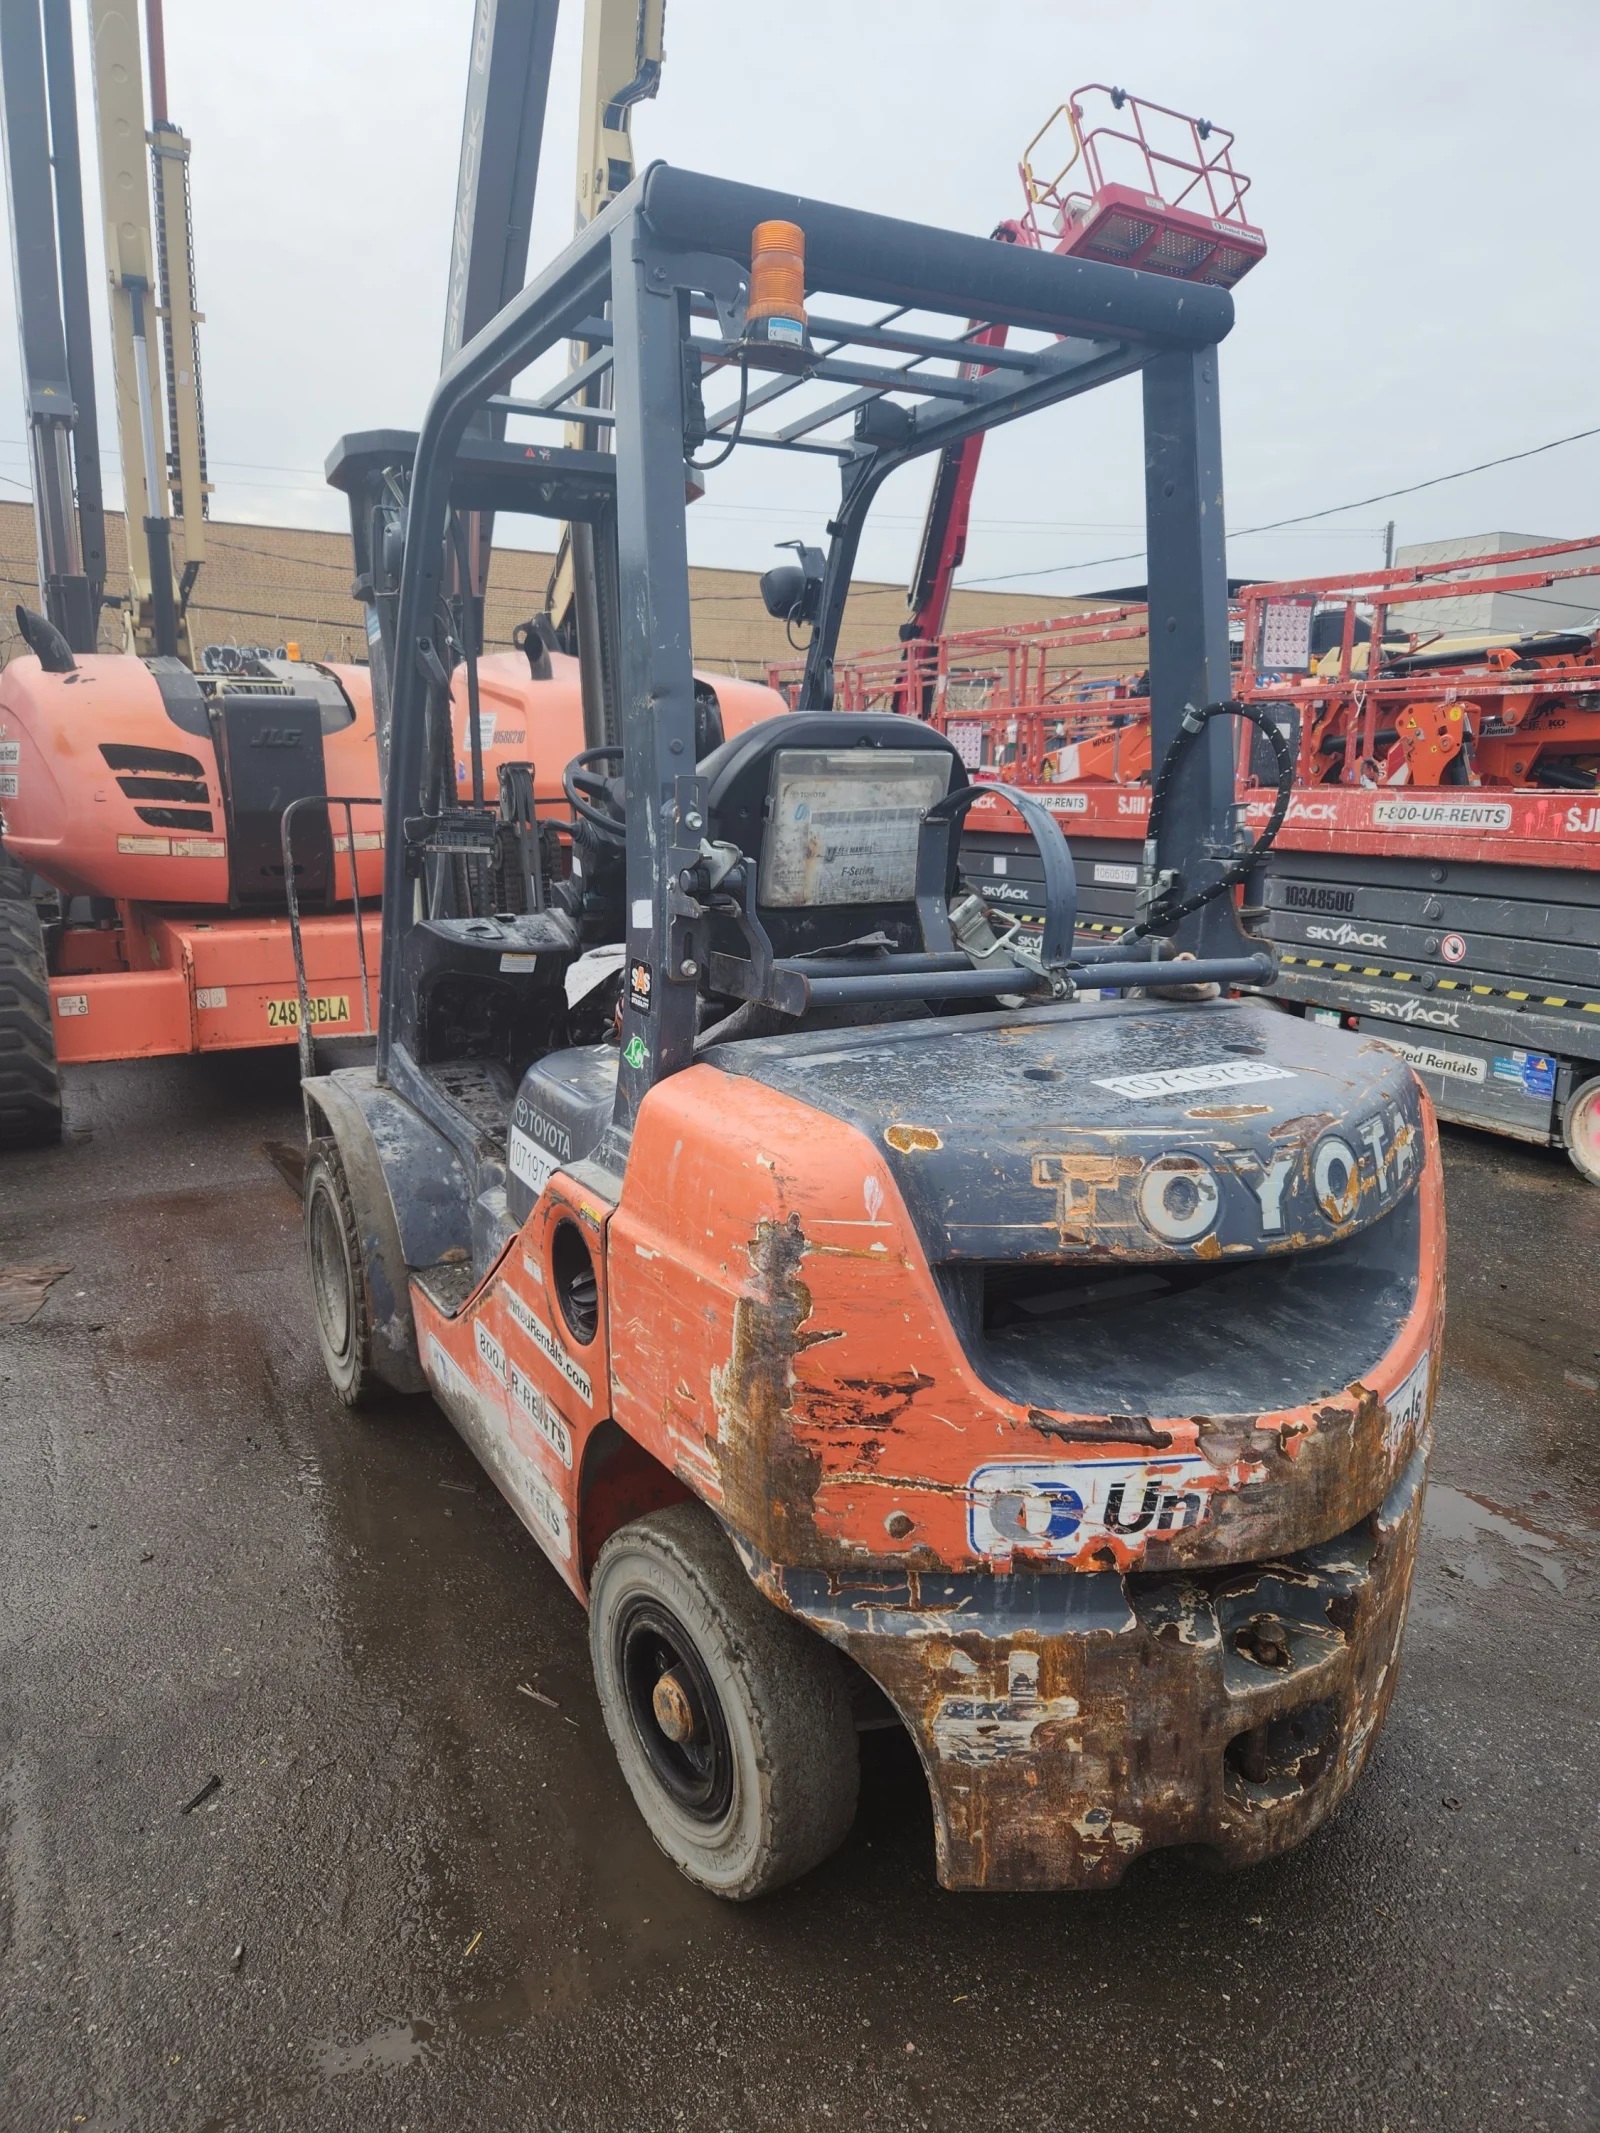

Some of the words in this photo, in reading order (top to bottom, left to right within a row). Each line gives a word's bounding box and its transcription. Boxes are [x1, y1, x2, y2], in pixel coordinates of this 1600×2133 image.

[449, 107, 483, 350] SKYJACK
[1222, 225, 1241, 236] United
[250, 728, 302, 748] JLG
[1486, 725, 1514, 735] Rentals
[971, 796, 997, 809] ACK
[1036, 797, 1085, 809] UR-RENTS
[1247, 795, 1338, 821] SKJACK
[1377, 805, 1505, 825] 1-800-UR-RENTS
[1096, 865, 1136, 881] 10605197
[981, 883, 1029, 900] SKYJACK
[1306, 922, 1387, 949] SKYJACK
[631, 965, 651, 995] SAS
[1369, 998, 1460, 1028] SKYJACK
[1111, 1061, 1284, 1095] 10719733
[1426, 1055, 1478, 1077] Rentals
[529, 1109, 571, 1161] TOYOTA
[1032, 1102, 1416, 1248] TOYOTA
[508, 1296, 591, 1400] nitedRentals.com
